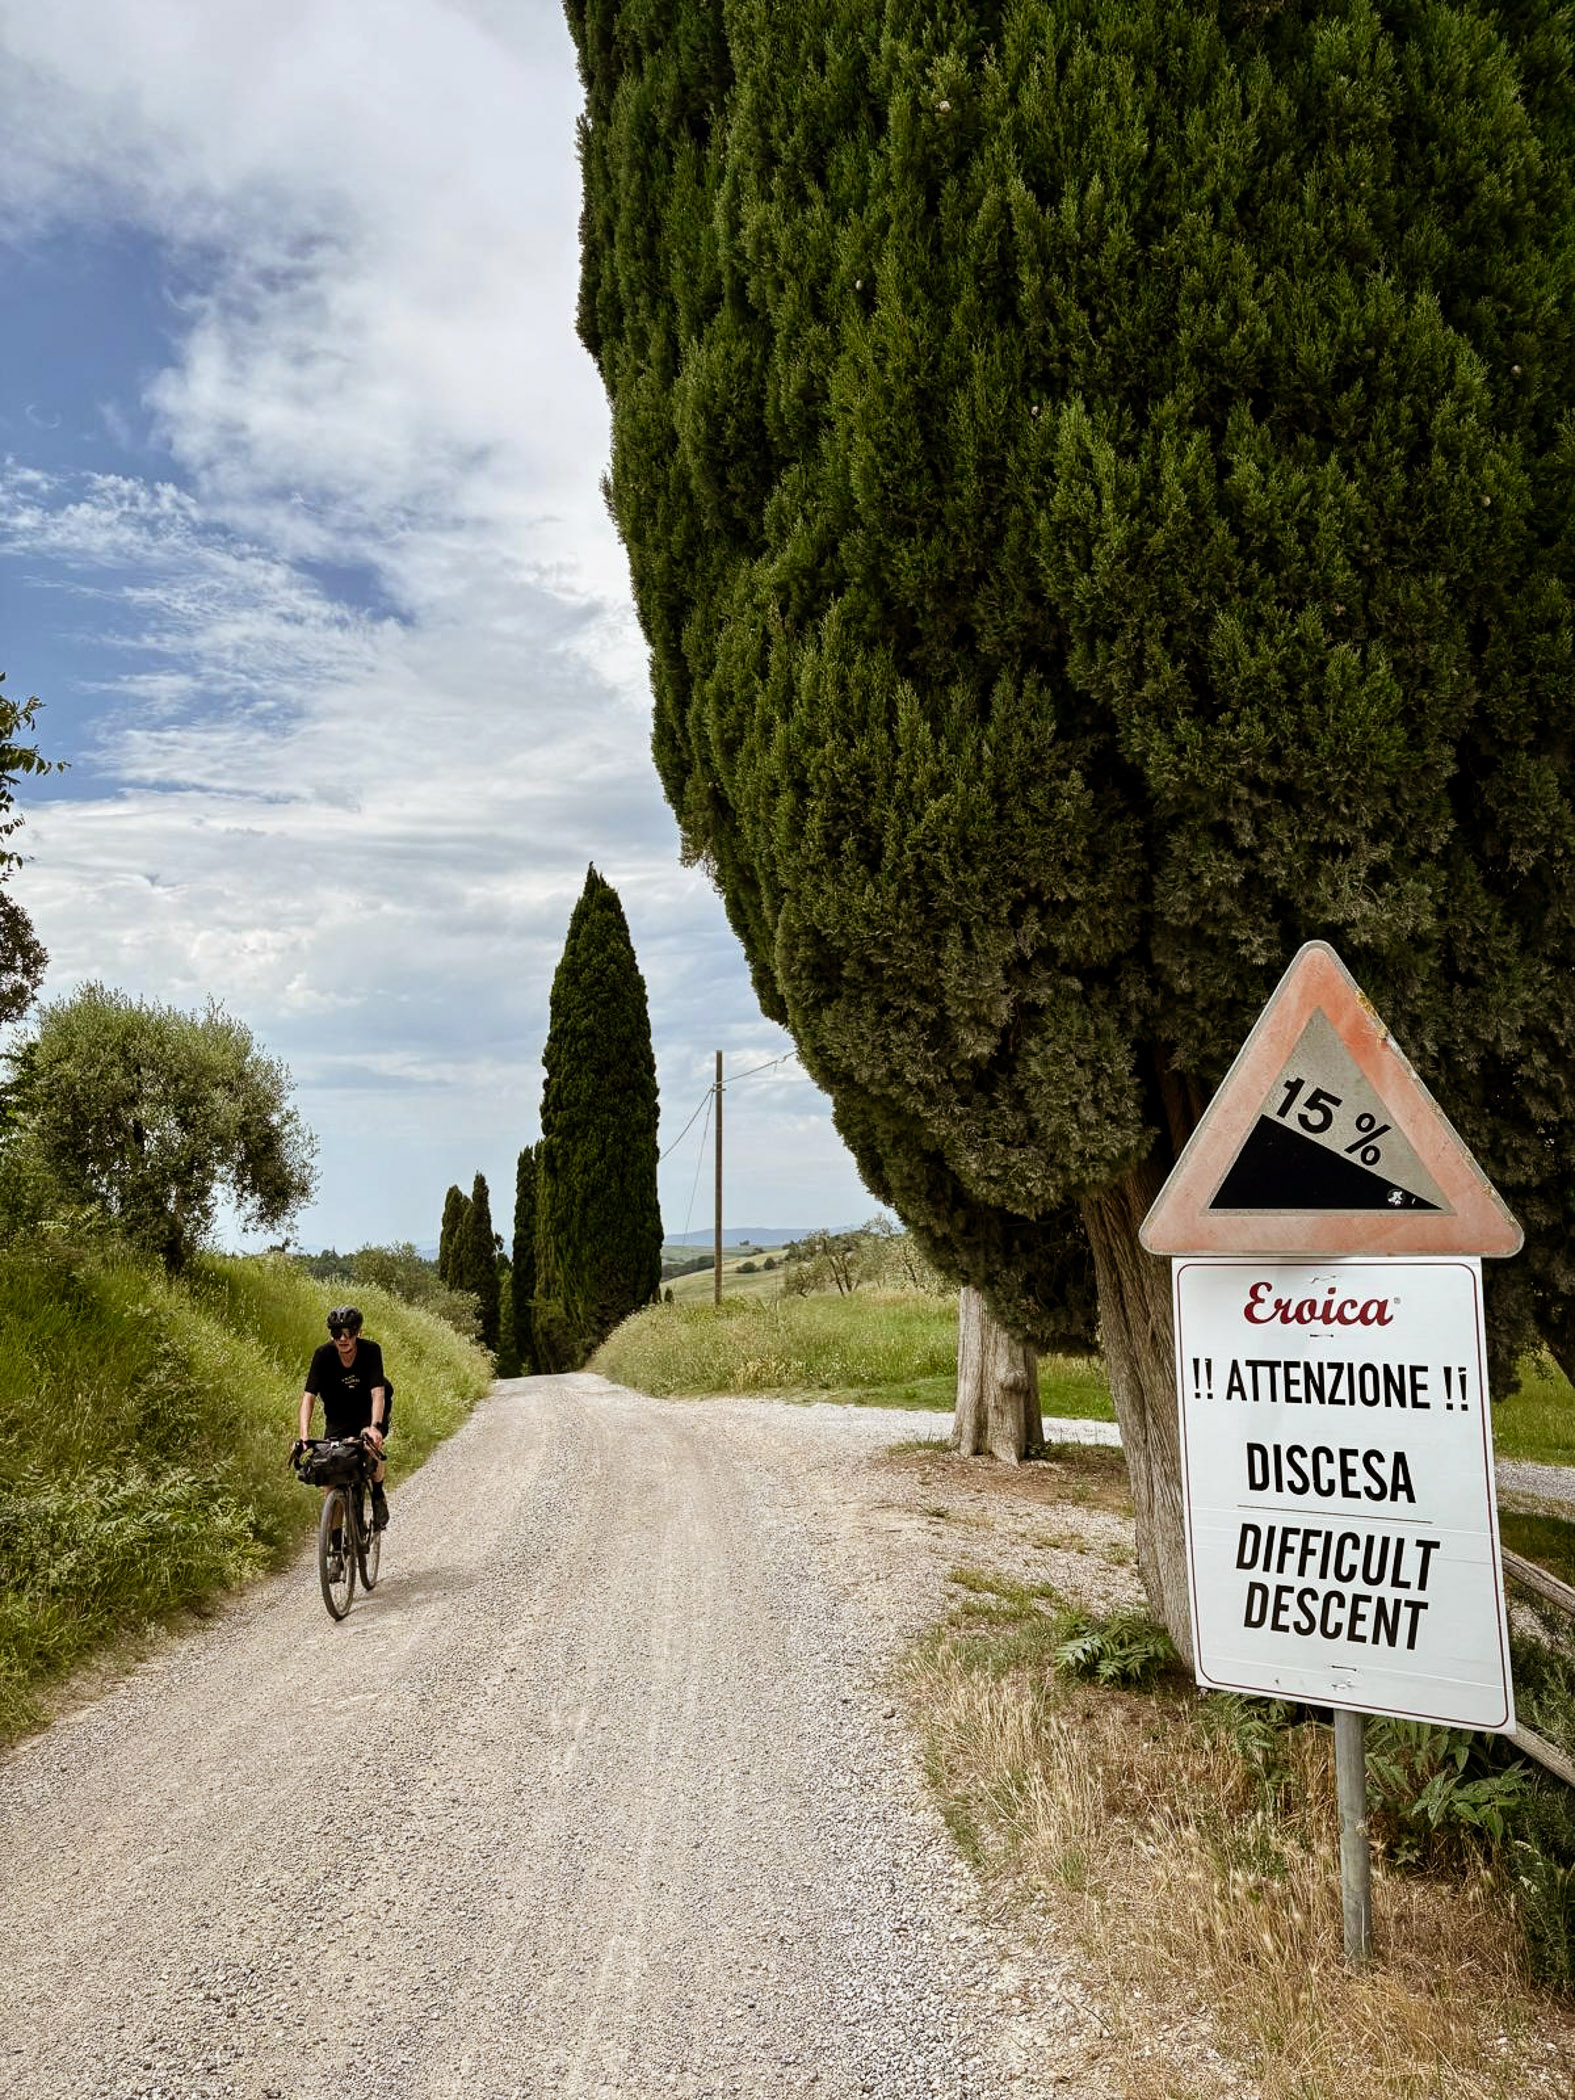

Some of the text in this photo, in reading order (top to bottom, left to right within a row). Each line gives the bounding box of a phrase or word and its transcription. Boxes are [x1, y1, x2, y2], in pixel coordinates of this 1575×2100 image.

[1276, 1077, 1392, 1166] 15 %
[1244, 1281, 1393, 1326] Eroica
[1192, 1357, 1213, 1400] !!
[1226, 1359, 1431, 1409] ATTENZIONE
[1246, 1442, 1416, 1503] DISCESA
[1236, 1523, 1440, 1591] DIFFICULT
[1243, 1582, 1429, 1650] DESCENT
